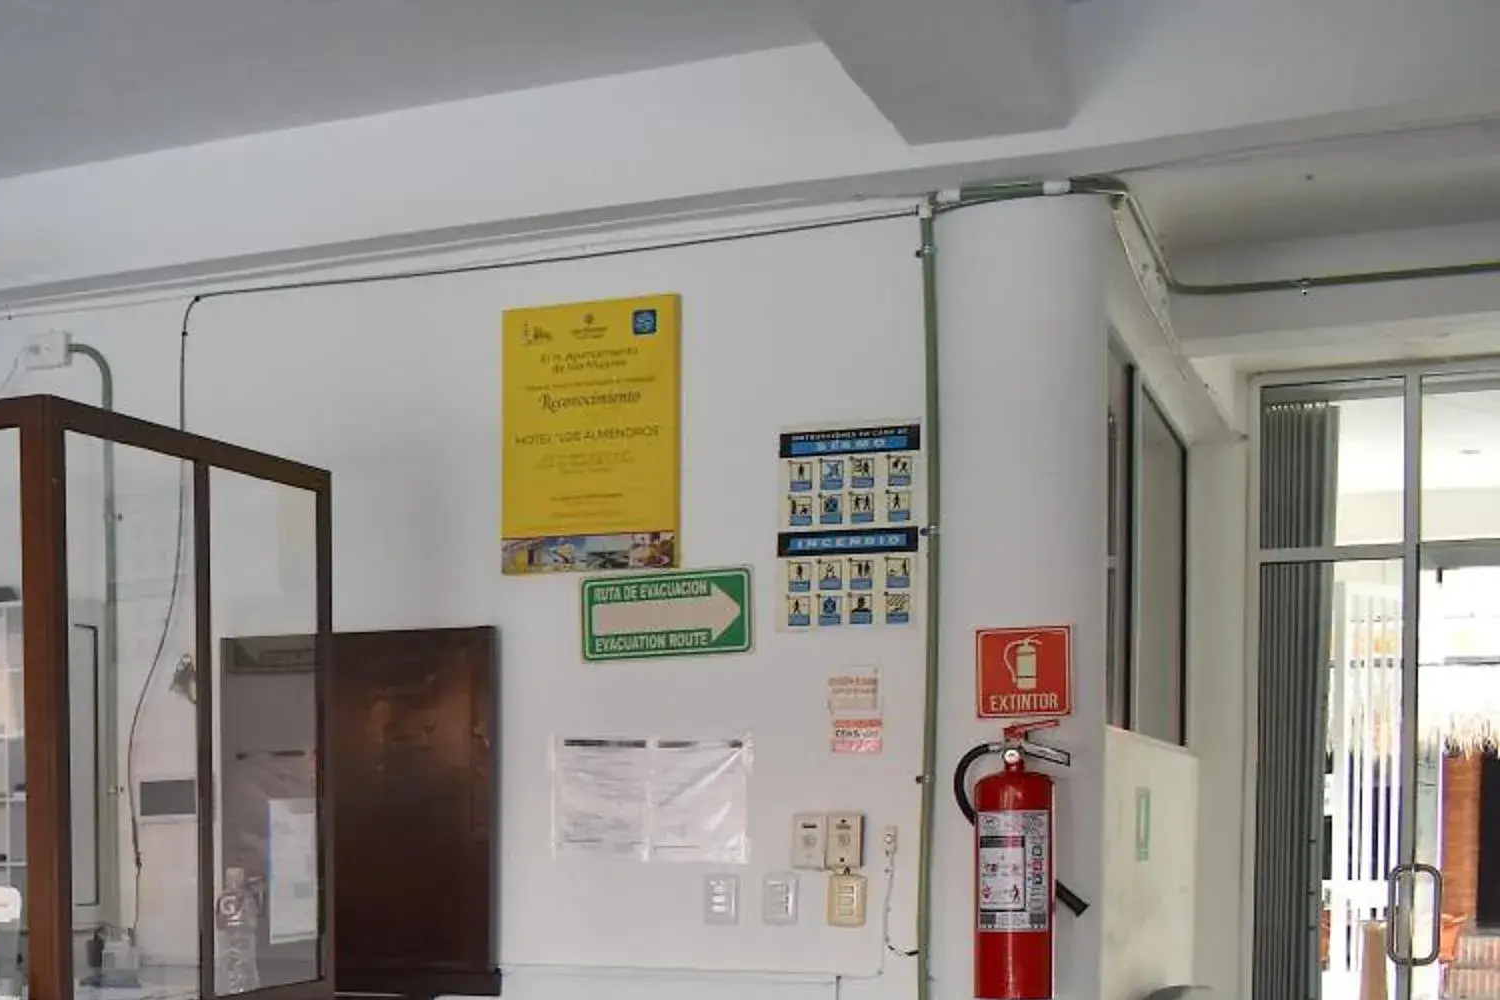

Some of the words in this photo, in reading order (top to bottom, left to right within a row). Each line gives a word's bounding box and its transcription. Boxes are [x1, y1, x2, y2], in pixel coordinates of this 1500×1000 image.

[538, 388, 642, 414] Reconocimiento
[796, 534, 900, 550] INCENDIO
[593, 586, 622, 601] RUTA
[623, 584, 638, 599] DE
[595, 633, 666, 653] EVACUATION
[668, 630, 710, 648] ROUTE
[989, 692, 1060, 712] EXTINTOR
